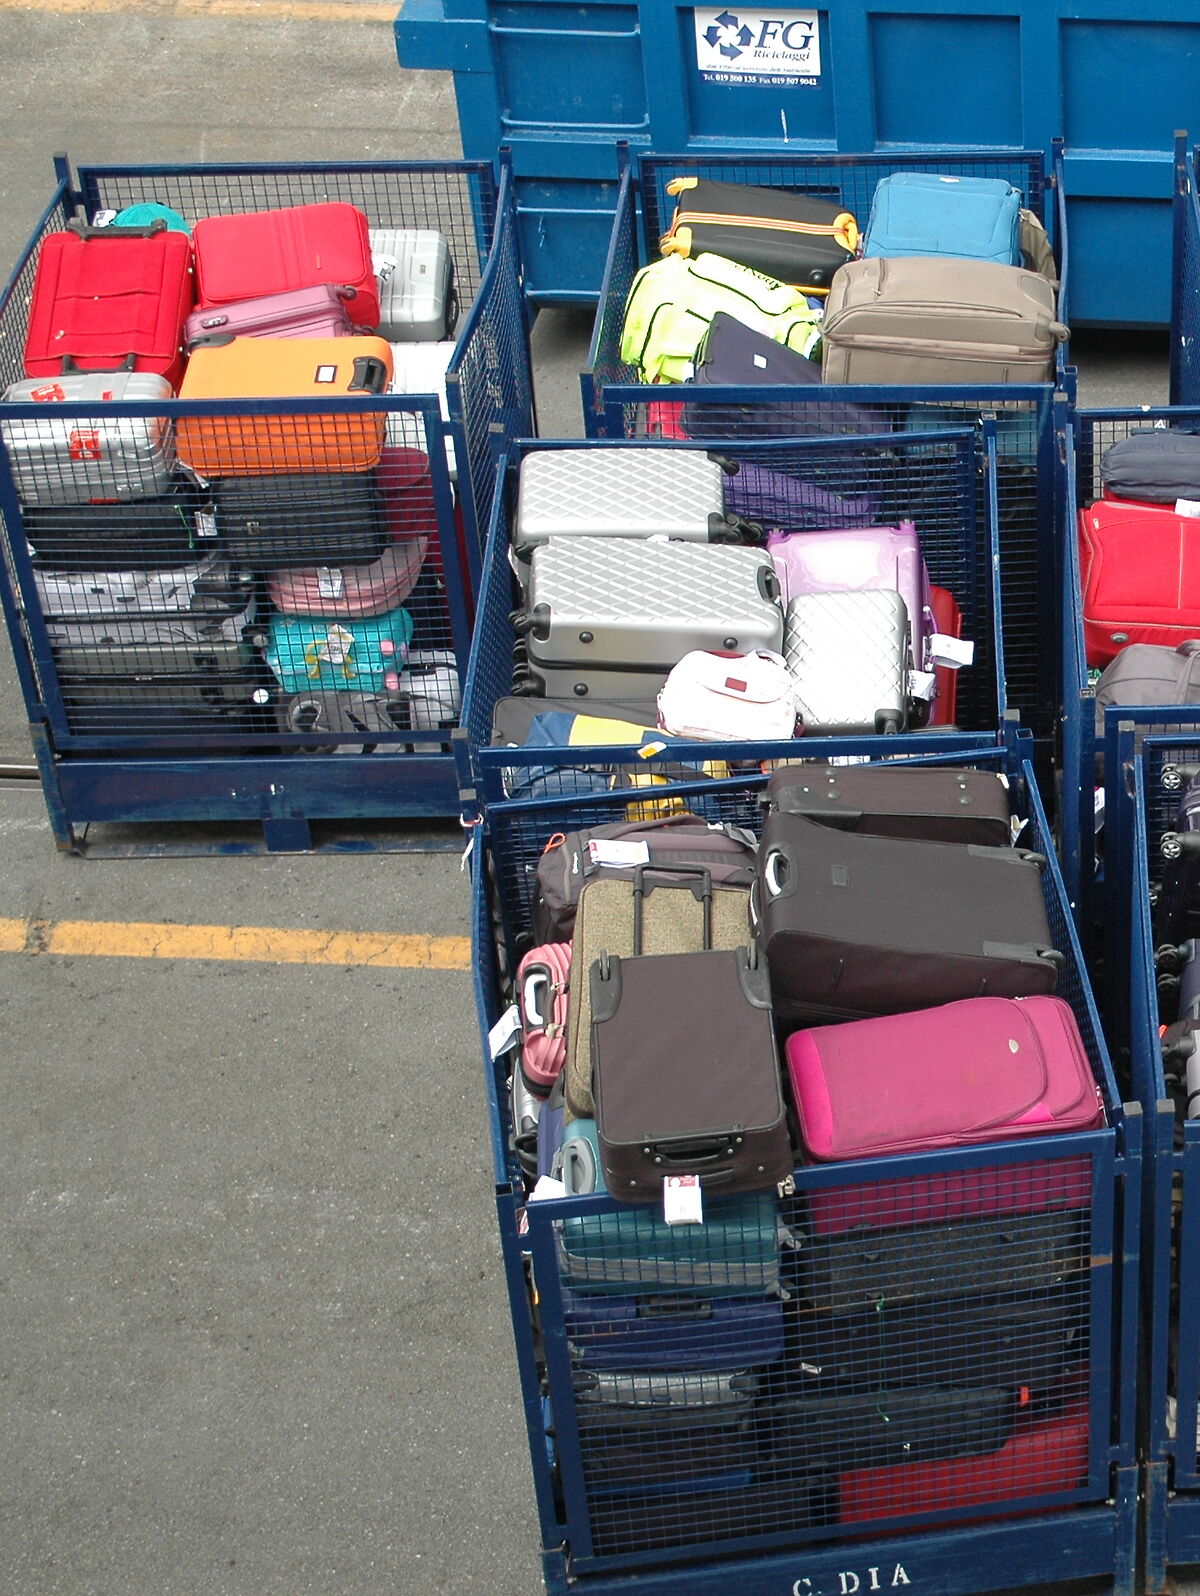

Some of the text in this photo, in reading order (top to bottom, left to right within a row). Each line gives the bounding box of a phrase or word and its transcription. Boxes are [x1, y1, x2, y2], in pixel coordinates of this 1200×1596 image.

[753, 50, 811, 61] Riciclaggi
[715, 74, 729, 82] 019
[838, 1563, 911, 1595] DIA
